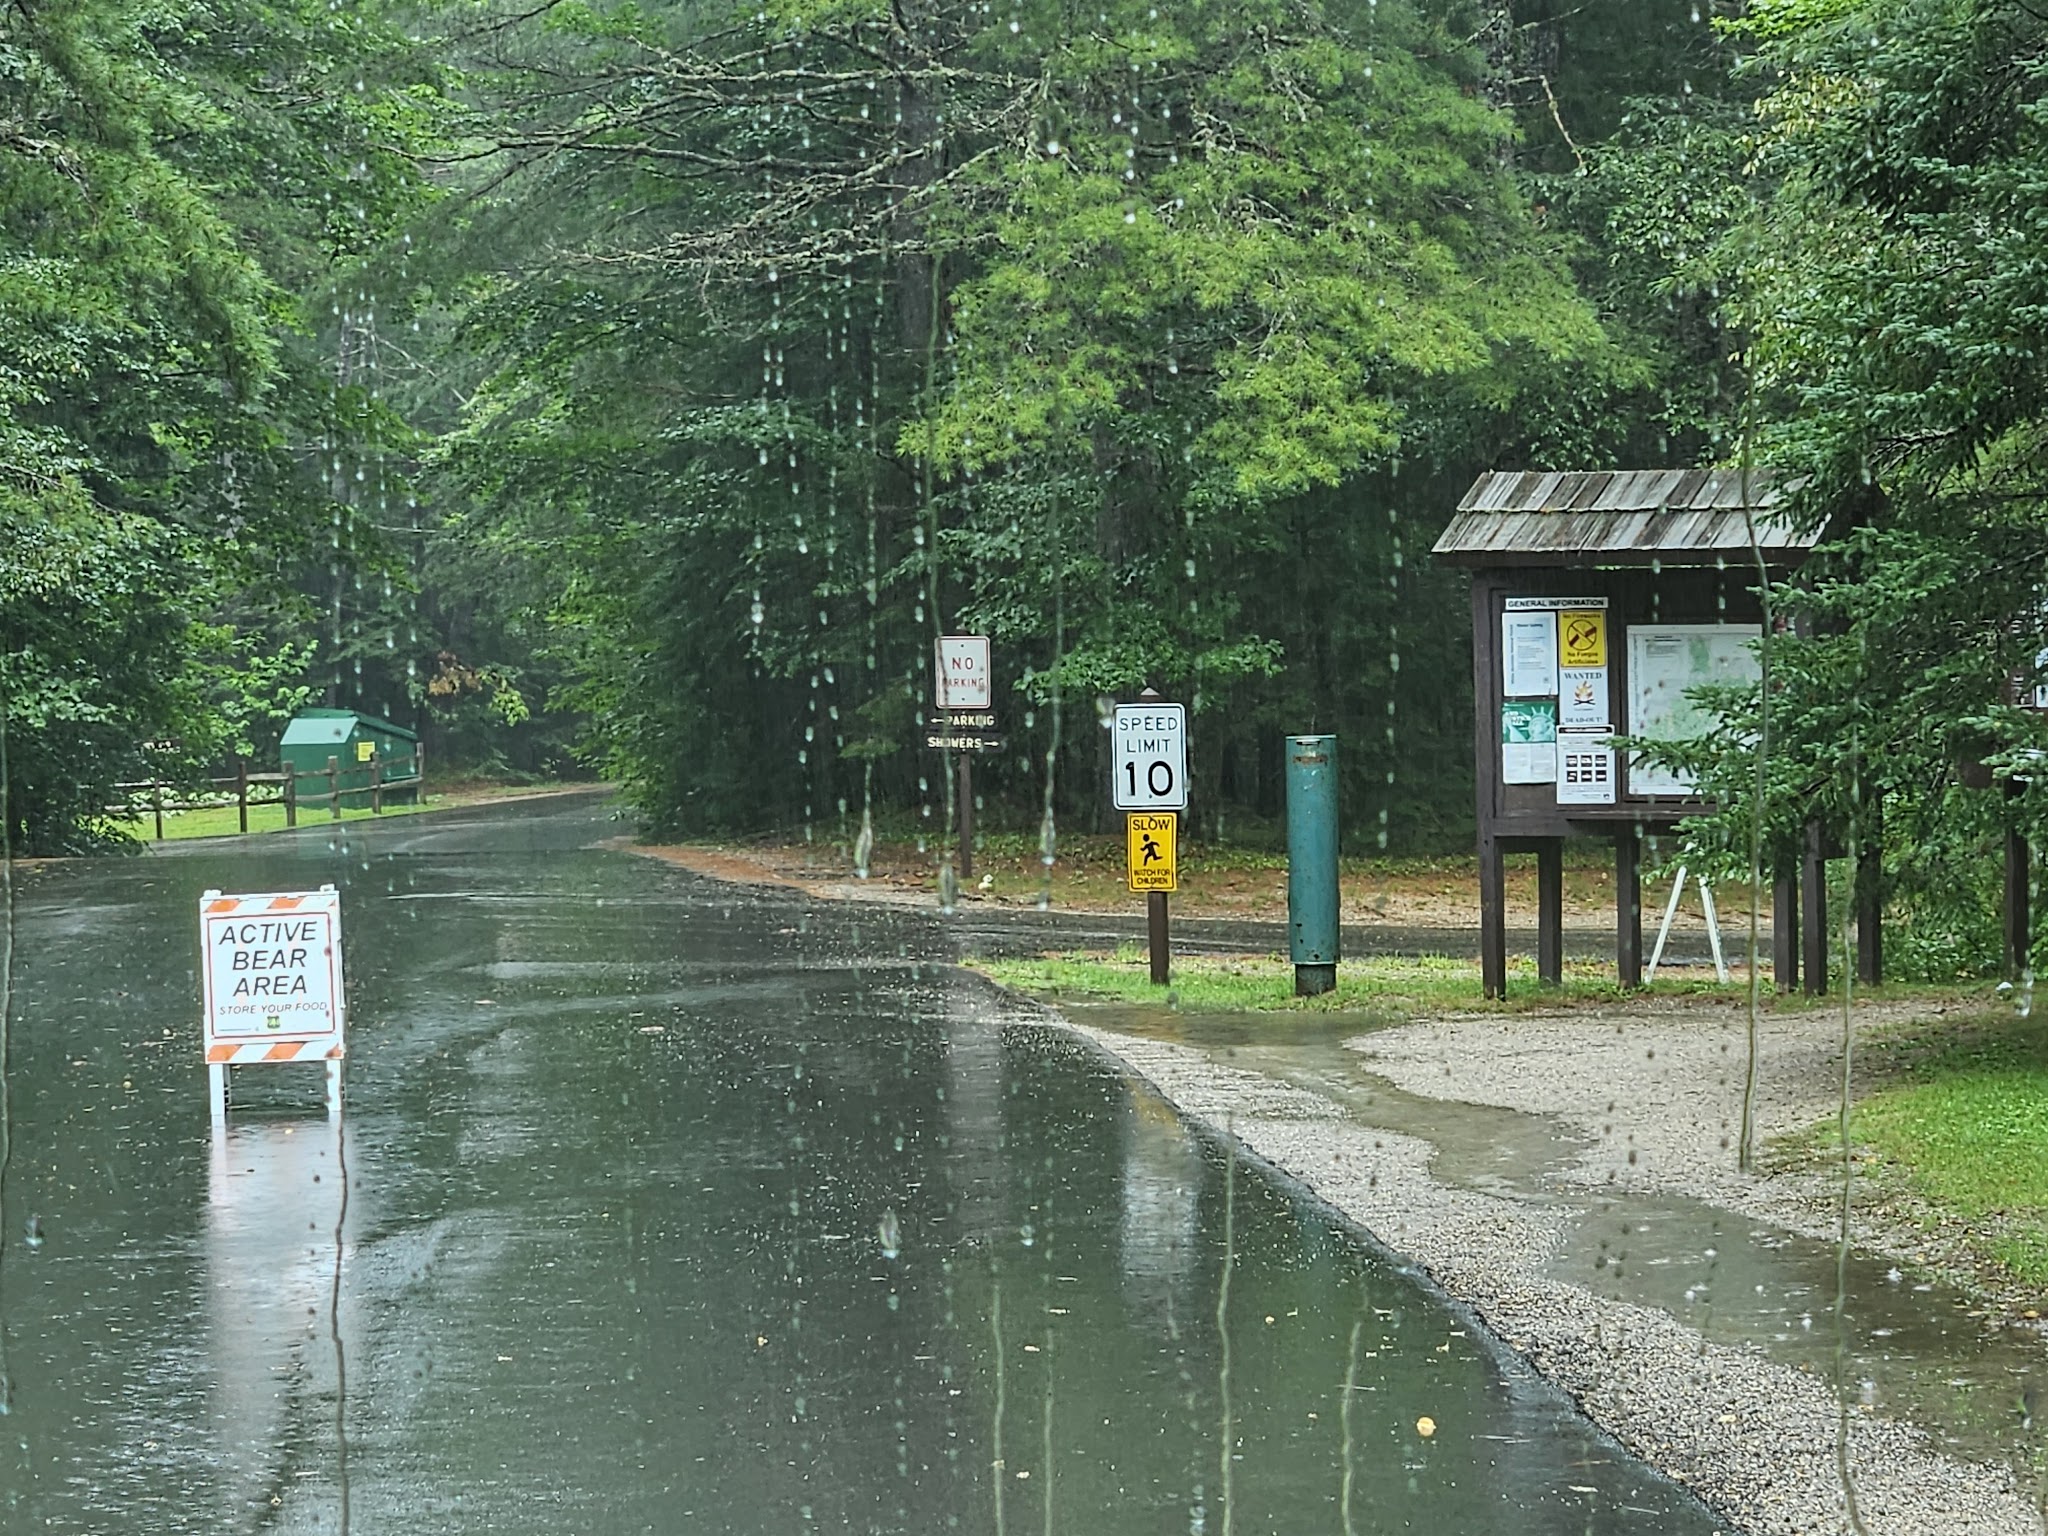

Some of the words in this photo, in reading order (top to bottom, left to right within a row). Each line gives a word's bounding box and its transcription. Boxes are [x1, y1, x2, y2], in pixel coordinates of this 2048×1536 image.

[1508, 599, 1547, 607] GENERAL
[1548, 598, 1605, 607] INFORMATION
[952, 657, 974, 670] NO
[943, 677, 984, 688] ARKING
[1564, 672, 1602, 680] WANTED
[1119, 716, 1178, 731] SPEED
[927, 737, 981, 748] SHOWERS
[1126, 738, 1171, 753] LIMIT
[1125, 760, 1174, 797] 10
[1132, 819, 1170, 831] SLOW
[1134, 869, 1156, 877] WATCH
[1136, 877, 1168, 885] CHILDREN
[219, 921, 317, 945] ACTIVE
[233, 949, 307, 970] BEAR
[233, 975, 307, 997] AREA
[220, 1005, 257, 1015] STORE
[261, 1004, 292, 1013] YOUR
[295, 1002, 327, 1012] FOOD
